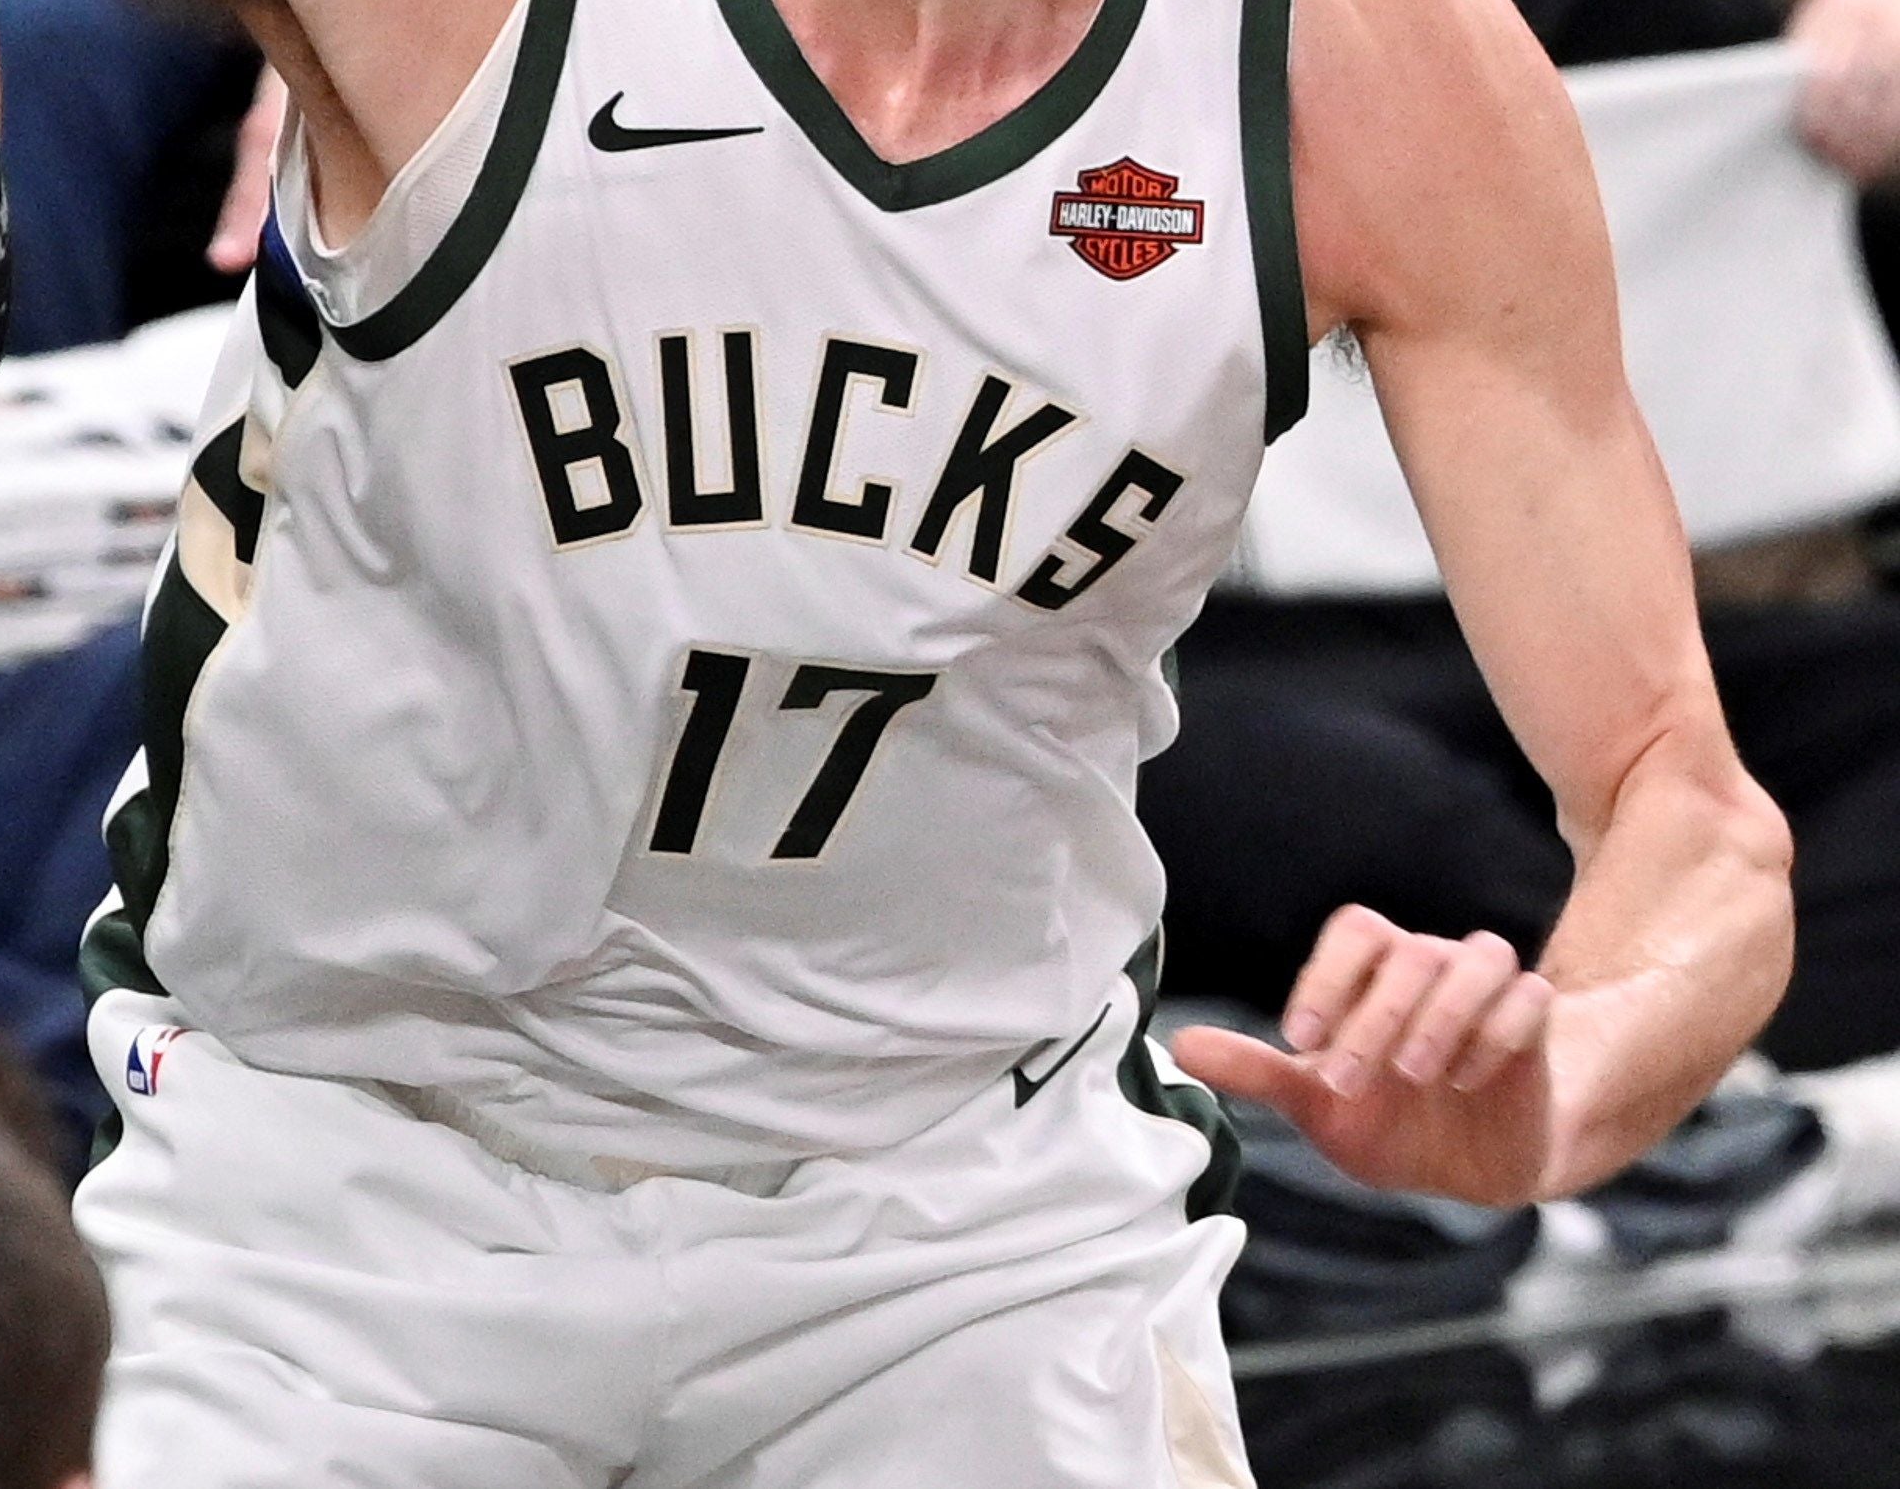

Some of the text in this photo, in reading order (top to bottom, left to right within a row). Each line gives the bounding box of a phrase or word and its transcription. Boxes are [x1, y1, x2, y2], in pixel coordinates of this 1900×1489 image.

[1090, 169, 1163, 198] MOTOR
[1058, 201, 1194, 234] HARLEY-DAVIDSON
[1085, 240, 1160, 270] CYCLES
[502, 323, 1189, 611] BUCKS
[646, 641, 946, 865] 17
